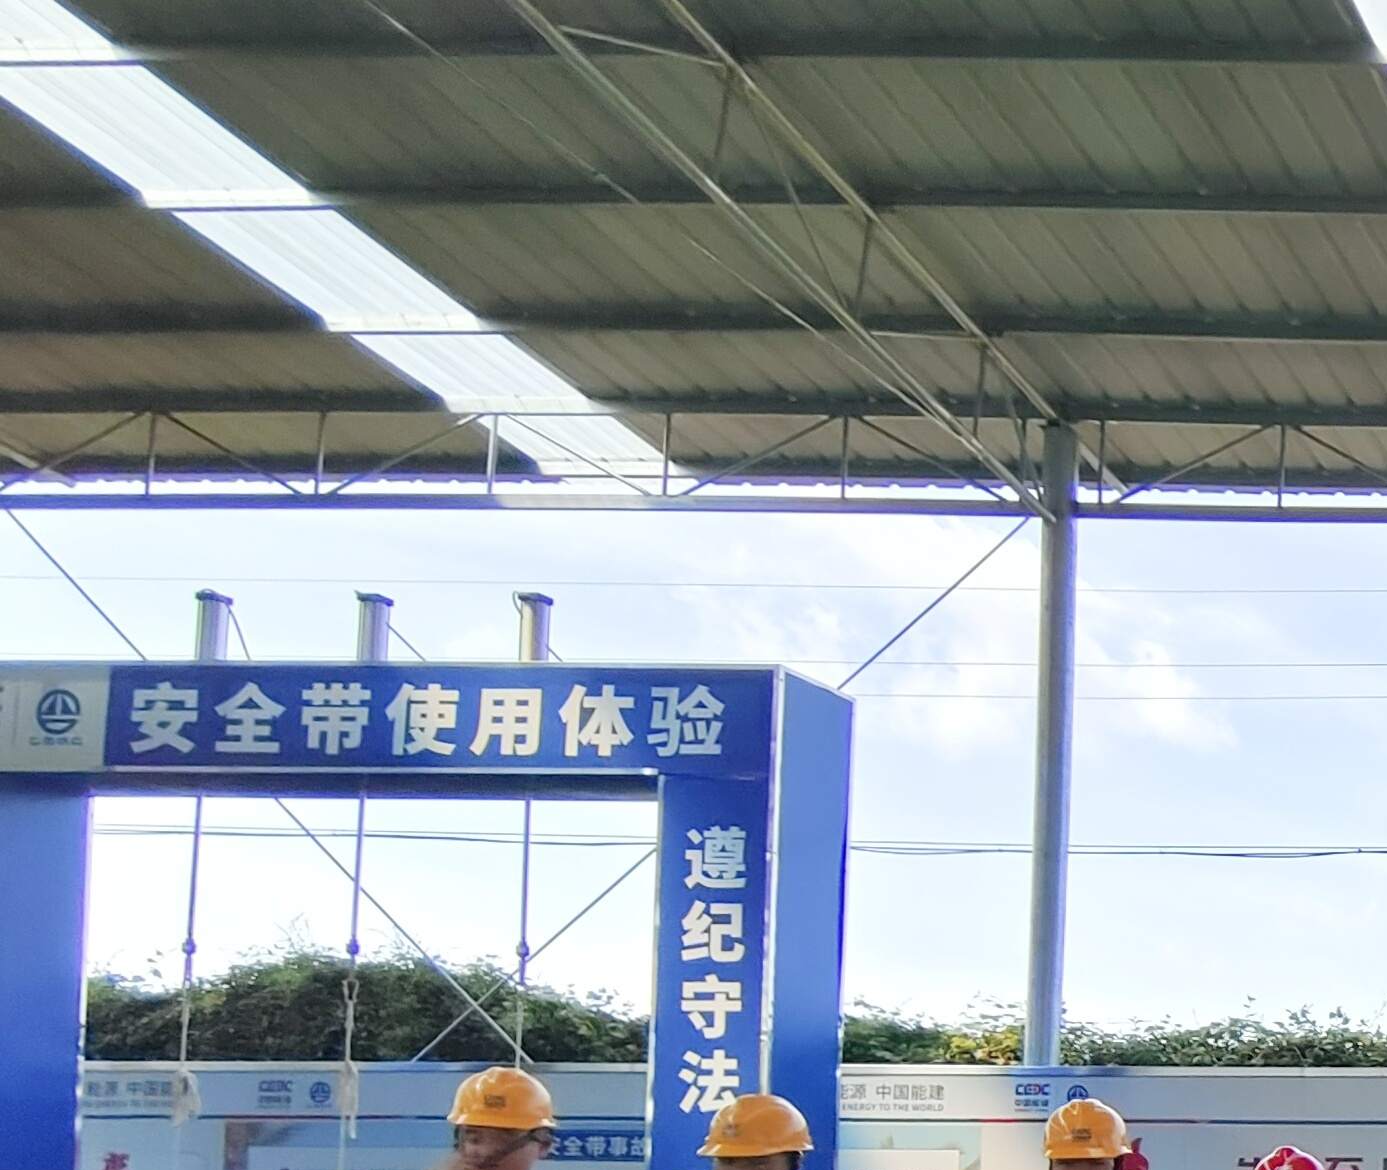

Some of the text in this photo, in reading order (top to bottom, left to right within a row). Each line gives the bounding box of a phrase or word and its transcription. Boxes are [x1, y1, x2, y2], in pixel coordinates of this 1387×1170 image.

[129, 682, 726, 758] 安全带使用体验
[678, 825, 747, 1114] 遵纪守法
[876, 1083, 945, 1101] 中国能建
